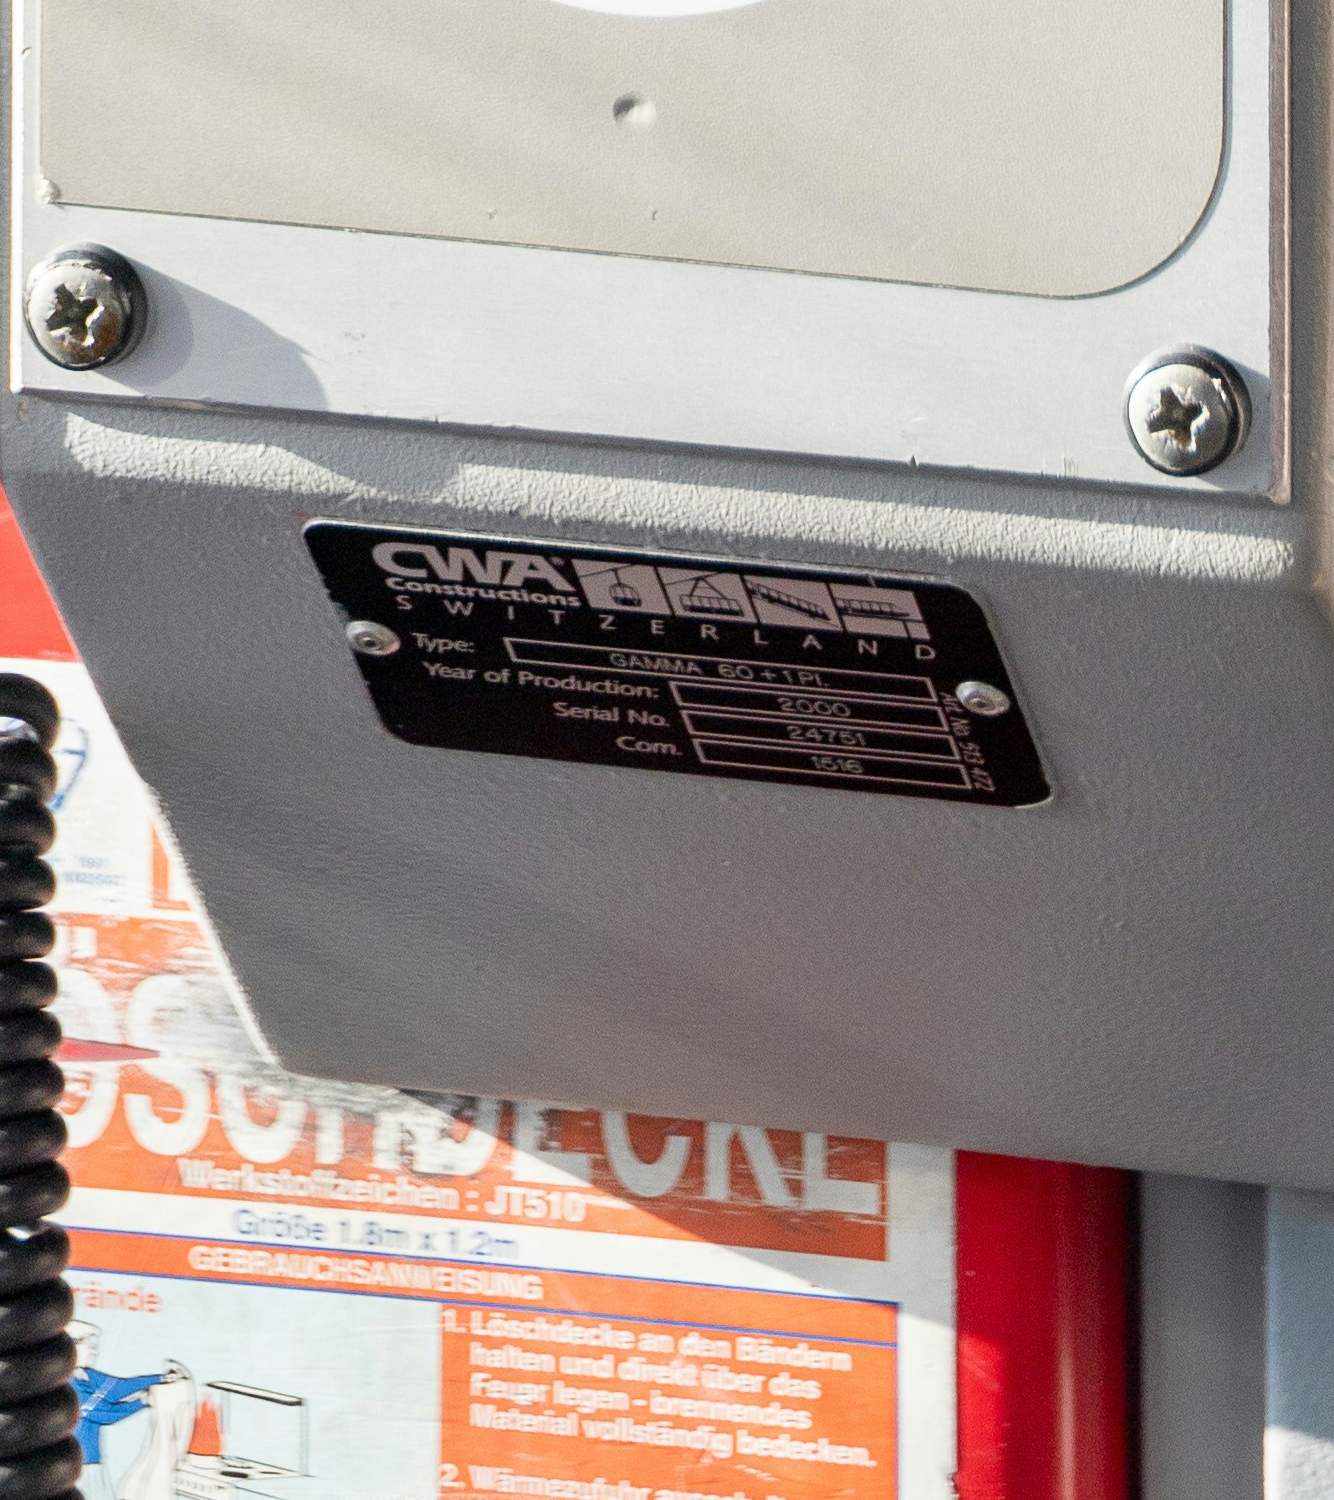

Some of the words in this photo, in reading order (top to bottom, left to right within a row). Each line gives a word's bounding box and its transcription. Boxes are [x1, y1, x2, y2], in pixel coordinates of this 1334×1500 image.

[372, 542, 576, 592] CWA
[385, 577, 582, 607] Constructions
[411, 632, 475, 654] Type:
[609, 652, 704, 676] GAMMA
[422, 661, 477, 680] Year
[483, 668, 512, 684] of
[518, 670, 659, 699] Production:
[777, 697, 851, 717] 2000
[553, 701, 618, 722] Serial
[627, 708, 670, 727] No.
[616, 735, 683, 756] Com.
[178, 1158, 460, 1212] Werkstoffzeichen
[485, 1186, 588, 1222] JT510
[233, 1208, 327, 1243] Größe
[188, 1246, 544, 1300] GEBRAUCHSANWEISUNG
[471, 1311, 634, 1350] Löschdecke
[637, 1334, 674, 1354] an
[678, 1332, 731, 1358] den
[736, 1337, 852, 1372] Bändern
[470, 1343, 555, 1373] halten
[560, 1355, 614, 1378] und
[618, 1356, 699, 1386] direkt
[701, 1364, 765, 1393] über
[770, 1373, 822, 1399] das
[470, 1373, 547, 1404] Feuer
[553, 1381, 630, 1414] legen
[470, 1404, 578, 1437] Material
[583, 1418, 734, 1458] vollständig
[737, 1430, 878, 1467] bedecken.
